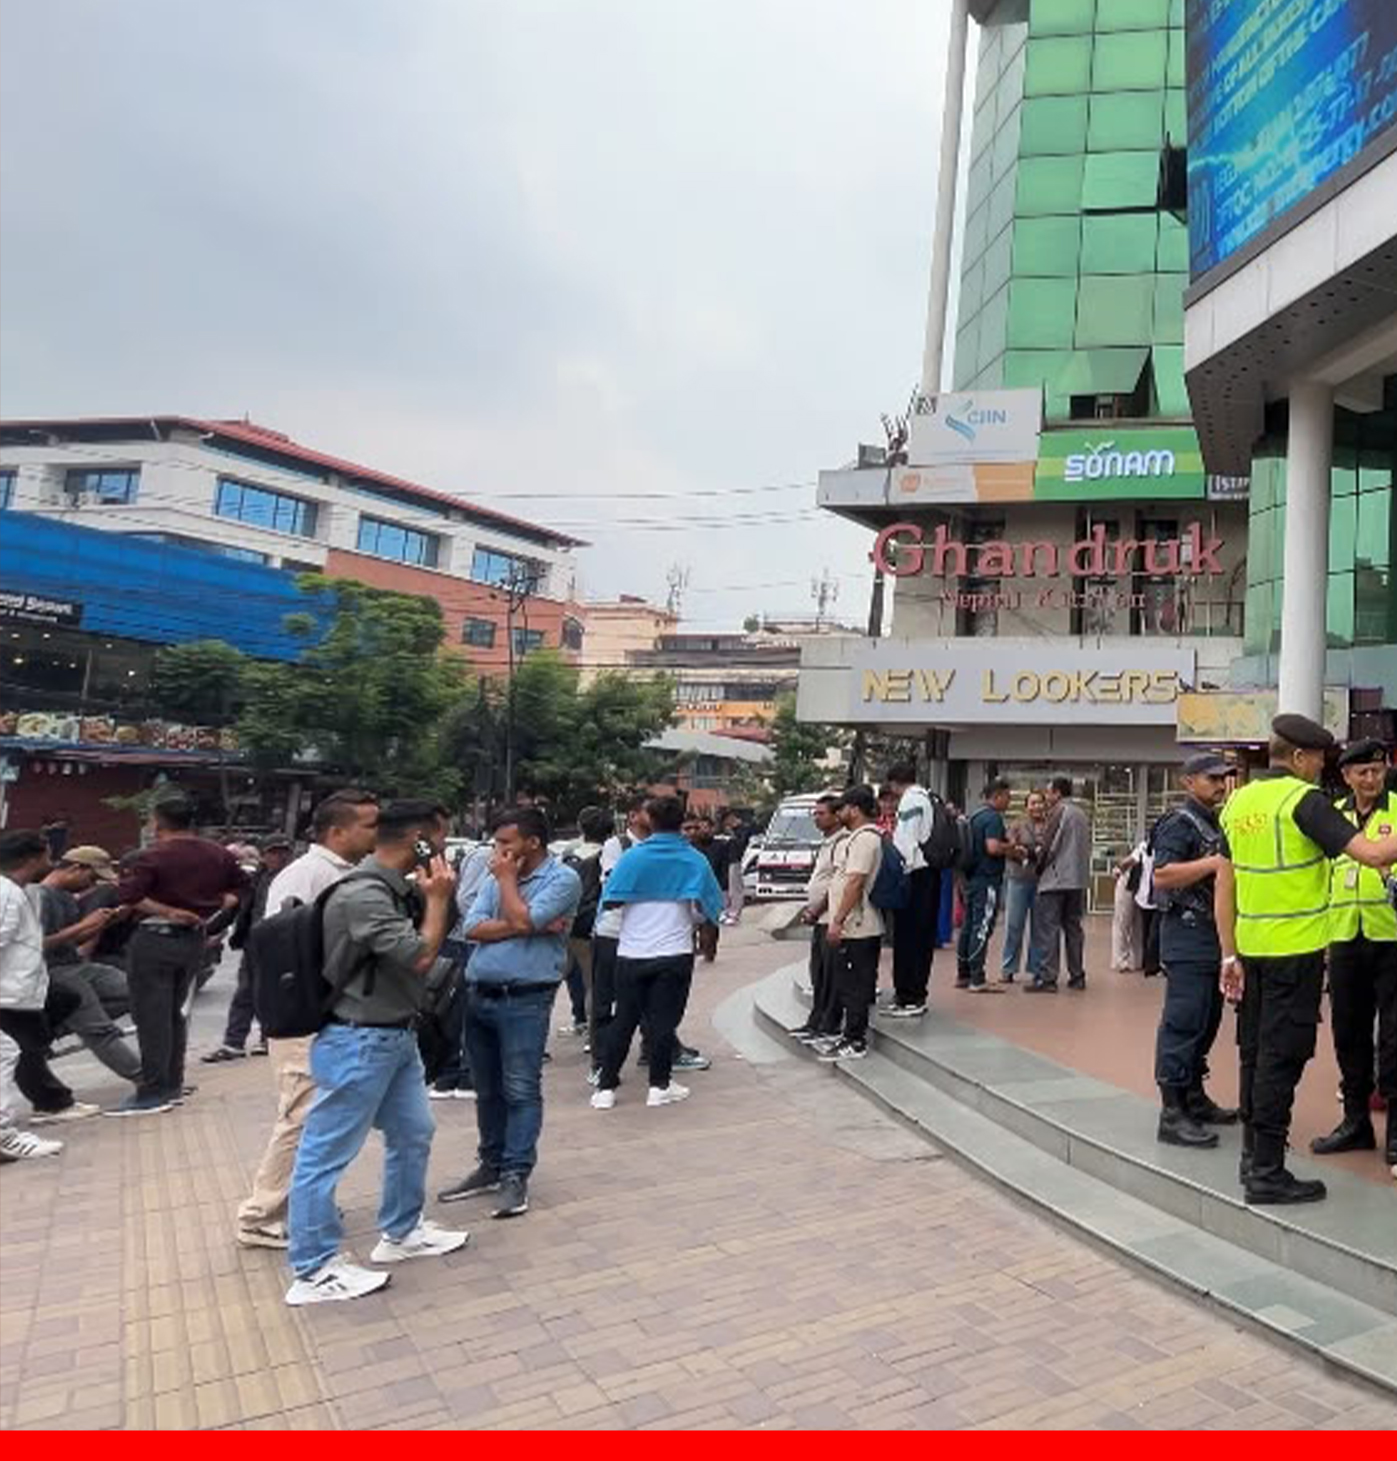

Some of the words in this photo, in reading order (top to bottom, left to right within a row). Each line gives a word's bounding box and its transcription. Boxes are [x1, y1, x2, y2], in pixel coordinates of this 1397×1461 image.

[1064, 443, 1176, 482] SONAM
[868, 522, 1225, 579] Ghandruk
[861, 668, 957, 704] NEW
[981, 668, 1181, 704] LOOKERS
